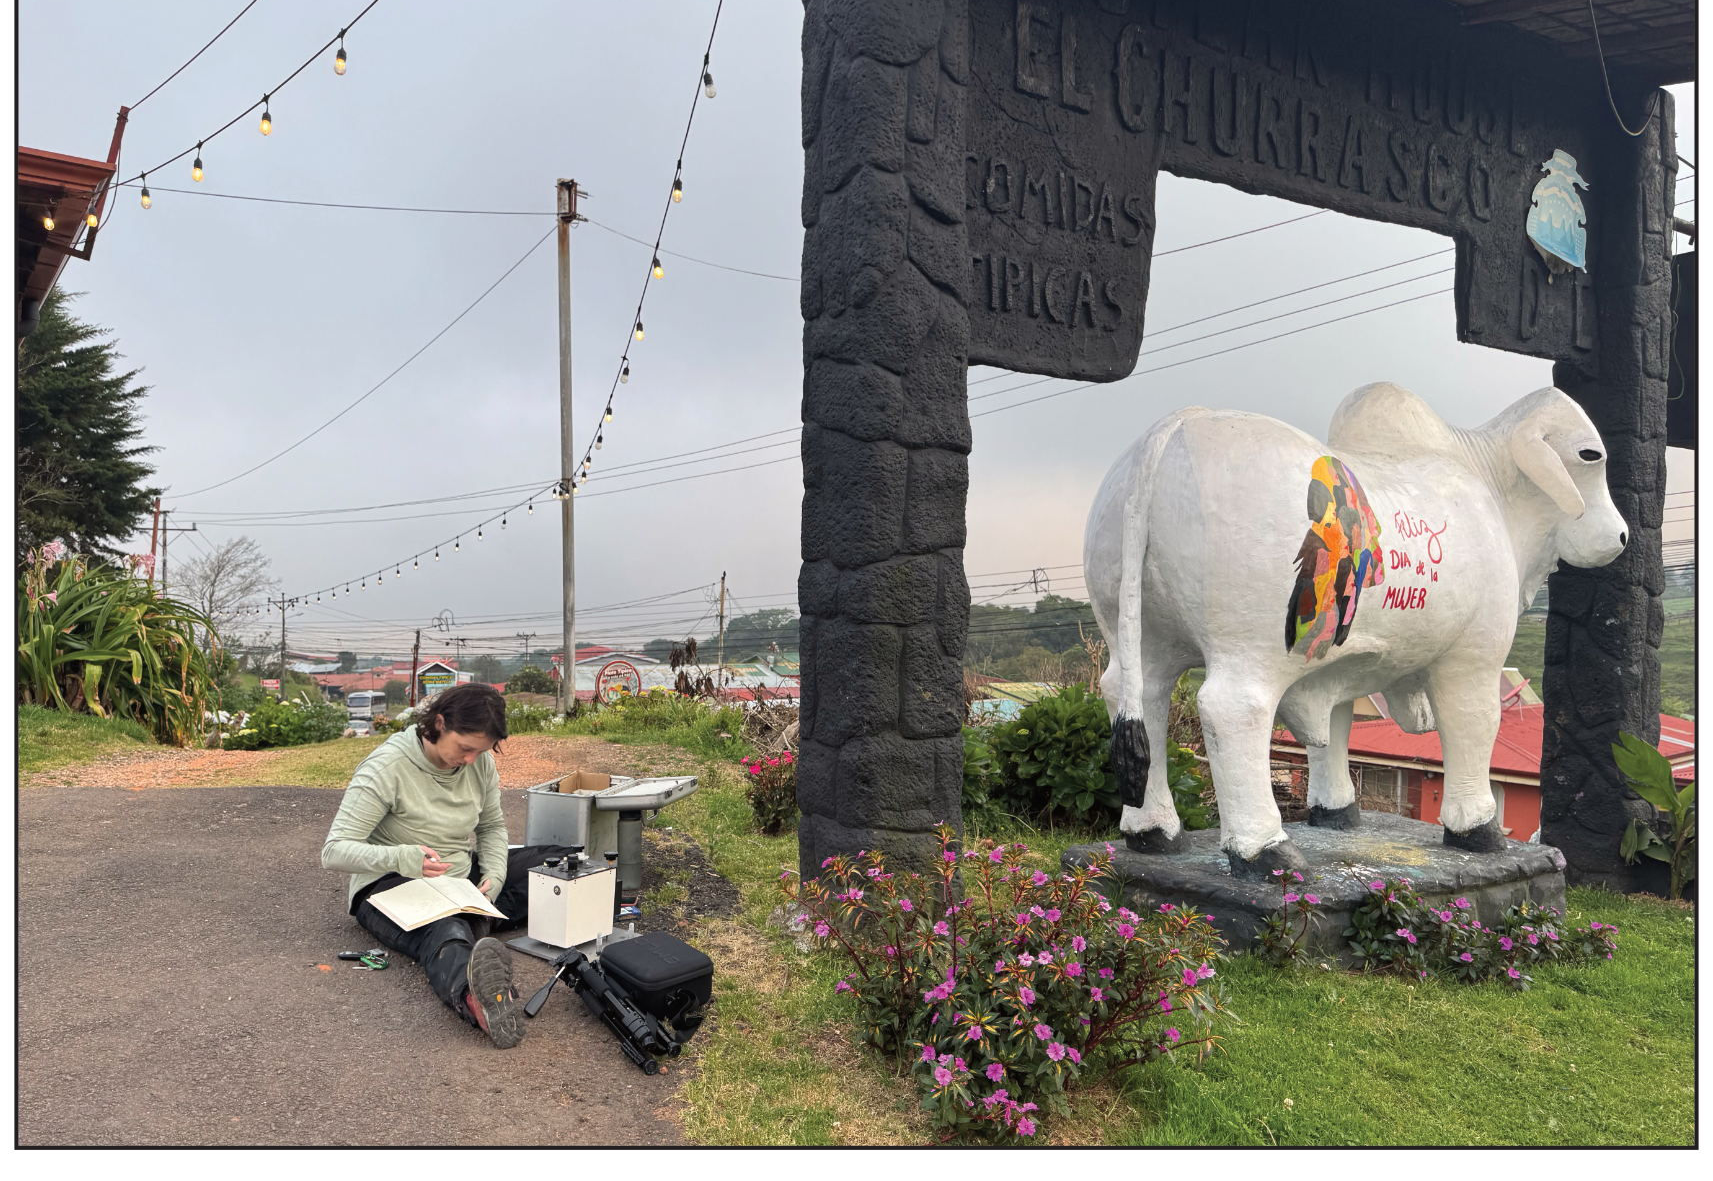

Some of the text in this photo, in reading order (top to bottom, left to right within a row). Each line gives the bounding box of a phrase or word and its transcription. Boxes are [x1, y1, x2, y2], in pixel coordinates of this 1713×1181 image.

[1014, 0, 1493, 224] EL CHURRASCO
[1394, 509, 1447, 564] Feliz
[1389, 549, 1438, 582] DIA de la
[1382, 585, 1427, 610] MUJER
